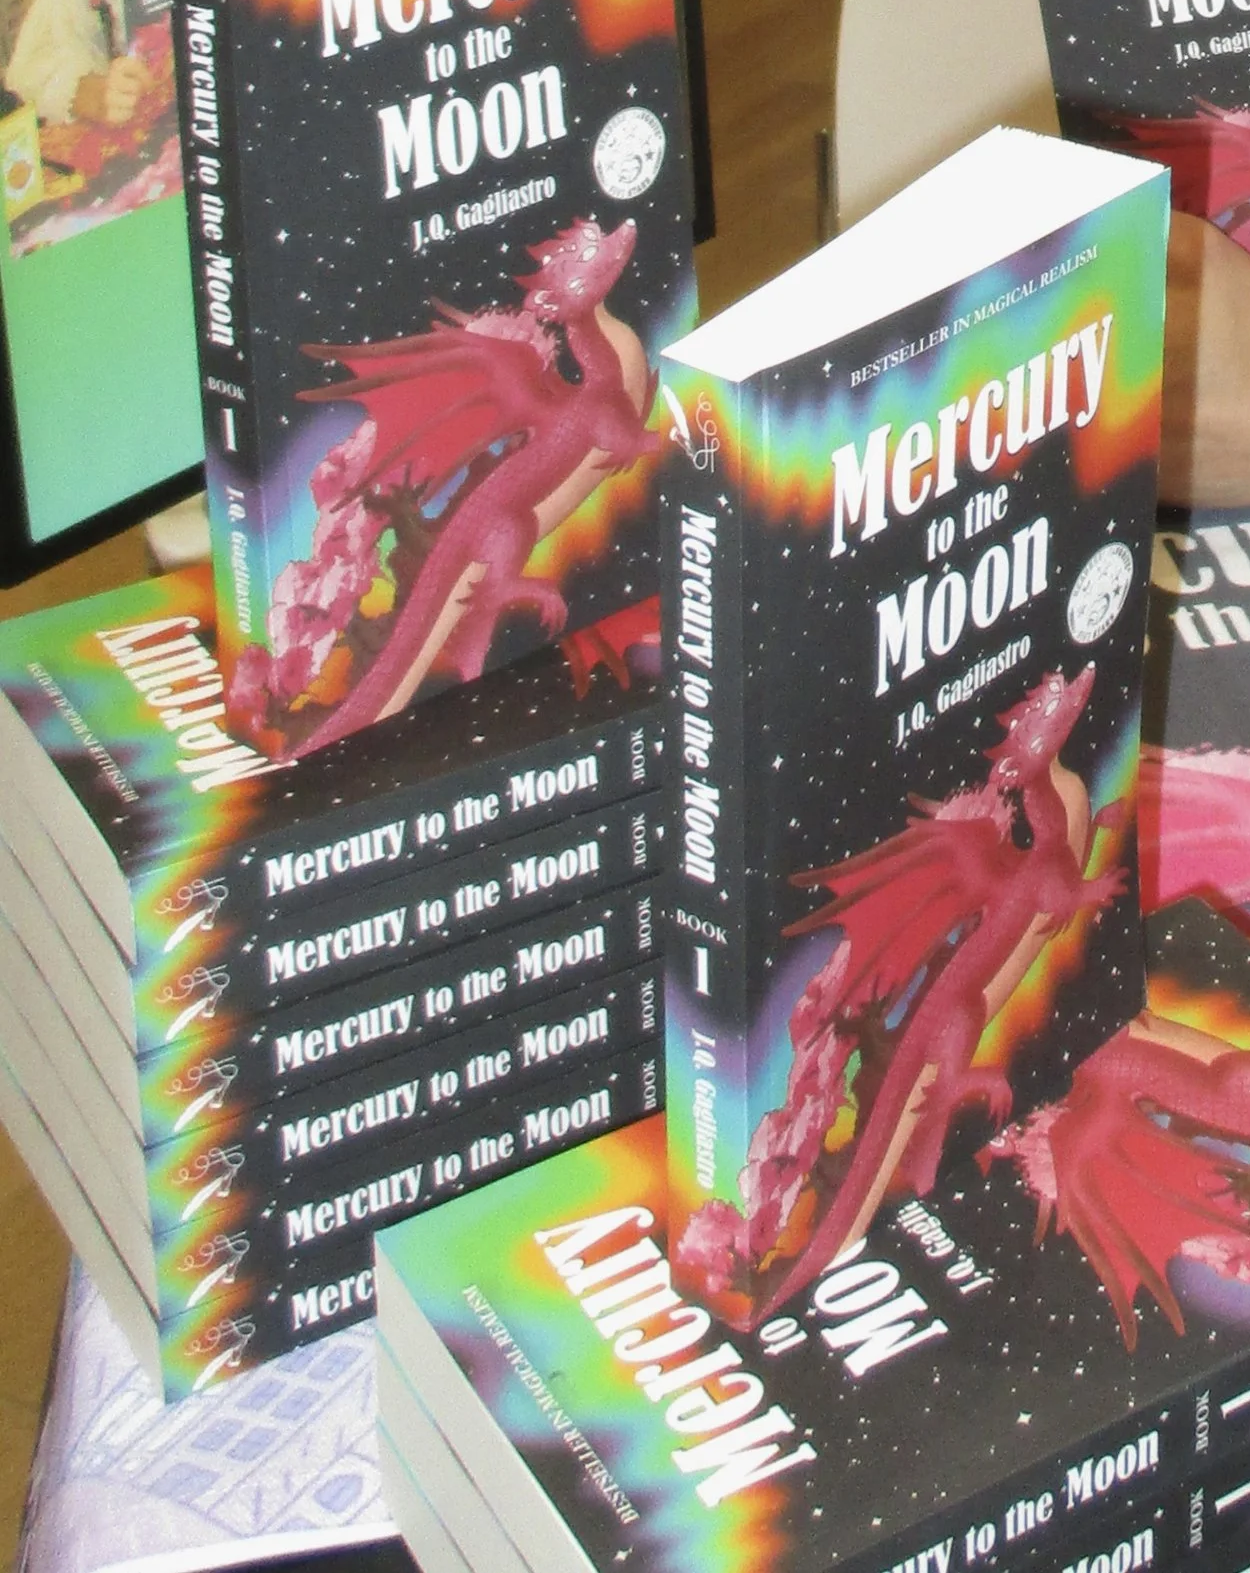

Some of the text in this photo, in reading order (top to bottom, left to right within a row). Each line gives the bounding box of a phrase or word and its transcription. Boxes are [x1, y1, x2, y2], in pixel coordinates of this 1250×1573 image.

[425, 25, 512, 83] to the
[1175, 41, 1206, 64] J.Q.
[187, 3, 235, 348] Mercury Moon
[378, 64, 568, 201] Moon
[412, 175, 556, 251] J.Q. Gagliastro
[850, 244, 1099, 388] BESTSELLER IN MAGICAL REALISM
[207, 376, 247, 401] BOOK
[829, 312, 1114, 560] Mercury
[926, 484, 1009, 564] to the
[875, 515, 1050, 698] Moon
[937, 634, 1031, 714] Gagliastro
[95, 616, 298, 794] Mercury
[631, 727, 645, 781] BOOK
[677, 503, 721, 885] Mercury to the Moon
[265, 753, 598, 897] Mercury to the Moon
[632, 812, 646, 866] BOOK
[266, 839, 600, 985] Mercury to the Moon
[676, 909, 728, 946] BOOK
[274, 924, 605, 1075] Mercury to the Moon
[281, 1006, 609, 1162] Mercury to the Moon
[692, 1077, 718, 1190] Gagliastro
[286, 1086, 611, 1248] Mercury to the Moon
[463, 1284, 641, 1525] BESTSELLER MAGICAL REALISM
[534, 1206, 818, 1508] Mercury
[759, 1317, 808, 1356] to
[965, 1430, 1160, 1567] to the Moon
